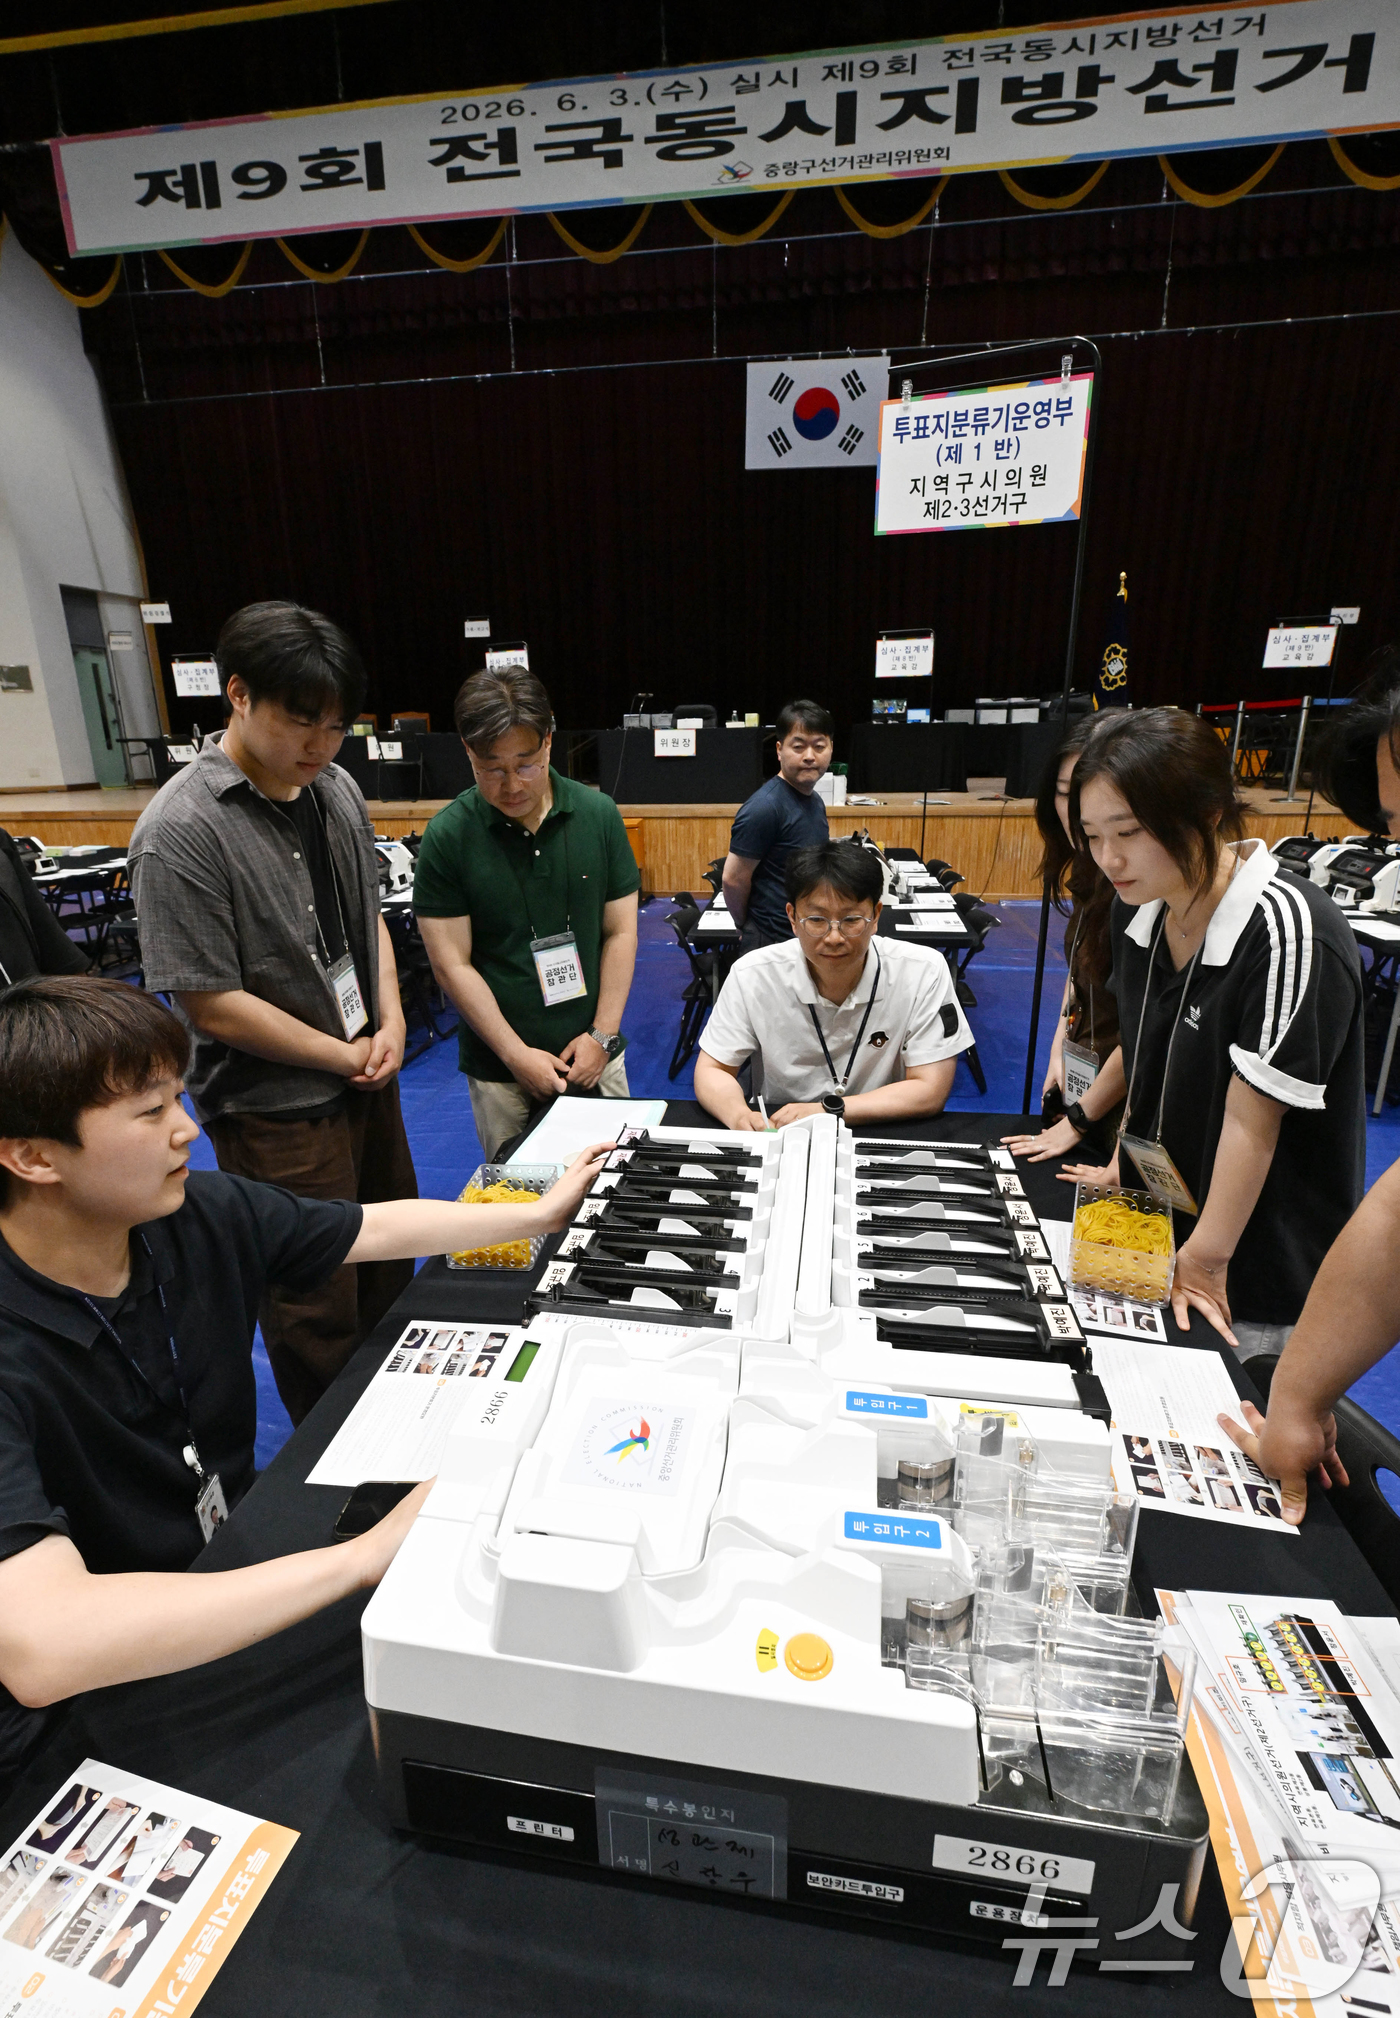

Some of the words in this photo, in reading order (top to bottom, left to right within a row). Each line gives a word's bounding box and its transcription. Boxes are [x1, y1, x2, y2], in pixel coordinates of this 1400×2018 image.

[440, 98, 537, 125] 2026.
[556, 93, 590, 113] 6.
[608, 76, 709, 108] 3.(수)
[730, 66, 800, 94] 실시
[821, 53, 918, 83] 제9회
[940, 12, 1266, 71] 전국동시지방선거
[134, 141, 387, 211] 제9회
[427, 32, 1376, 184] 전국동시지방선거
[763, 145, 951, 178] 중랑구선거관리위원회
[892, 396, 1074, 444] 투표지분류기운영부
[936, 443, 963, 467] (제
[973, 442, 982, 461] 1
[993, 436, 1021, 461] 반)
[909, 463, 1047, 497] 지역구시의원
[923, 492, 1028, 521] 제2·3선거구
[660, 737, 691, 748] 위원장
[1050, 1307, 1073, 1334] 박예진
[480, 1390, 510, 1425] 2866
[853, 1397, 902, 1411] 투입구
[582, 1424, 598, 1465] ELECTION
[601, 1405, 664, 1422] COMMISSION
[658, 1416, 685, 1482] 중앙선거관리위원회
[853, 1520, 911, 1538] 투입구
[915, 1530, 930, 1538] 2
[644, 1796, 736, 1823] 특수봉인지
[515, 1819, 563, 1838] 프린터
[616, 1854, 648, 1872] 서명
[967, 1846, 1061, 1880] 2866
[807, 1872, 902, 1901] 보안카드투입구
[146, 1847, 271, 2018] 투표지분류기
